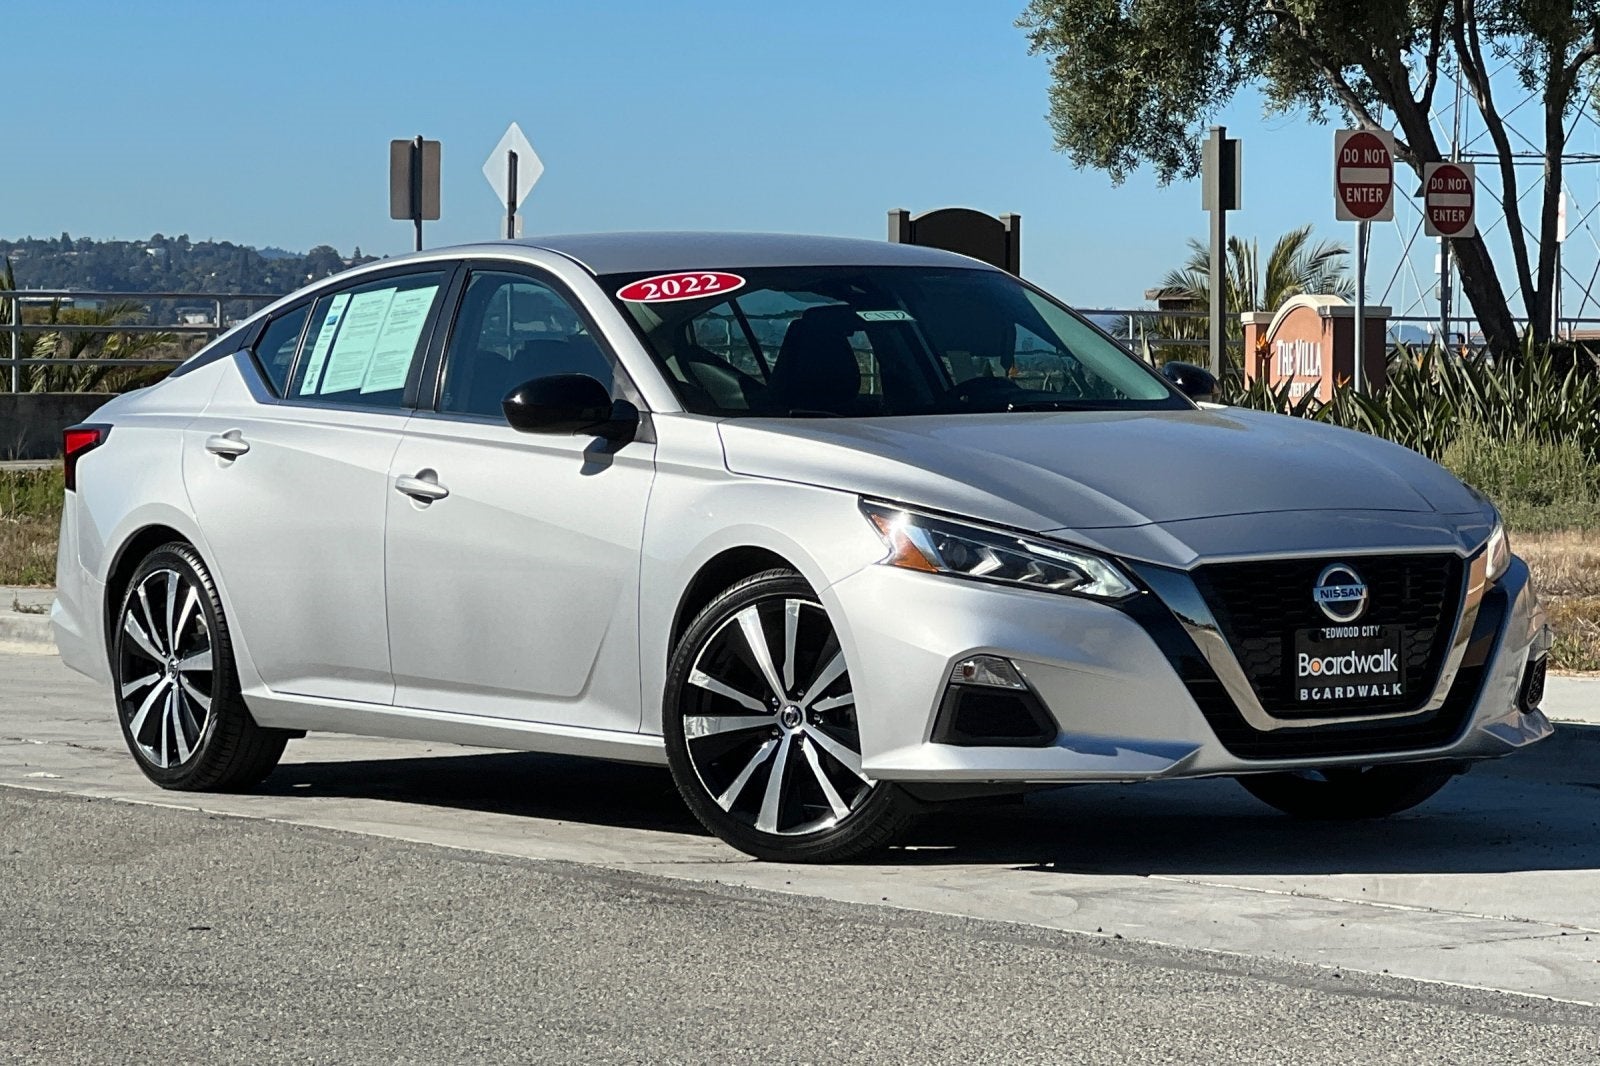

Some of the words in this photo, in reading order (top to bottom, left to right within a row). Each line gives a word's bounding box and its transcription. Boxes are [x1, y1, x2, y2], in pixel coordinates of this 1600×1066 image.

[1343, 148, 1359, 164] DO
[1364, 148, 1386, 164] NOT
[1431, 177, 1444, 190] DO
[1447, 178, 1467, 191] NOT
[1346, 187, 1383, 203] ENTER
[1433, 209, 1465, 222] ENTER
[641, 274, 720, 300] 2022
[1276, 340, 1294, 376] THE
[1295, 339, 1322, 376] VILLA
[1320, 588, 1363, 599] NISSAN
[1361, 625, 1380, 637] CITY
[1298, 648, 1398, 677] Boardwalk
[1300, 683, 1402, 701] BOARDWALK
